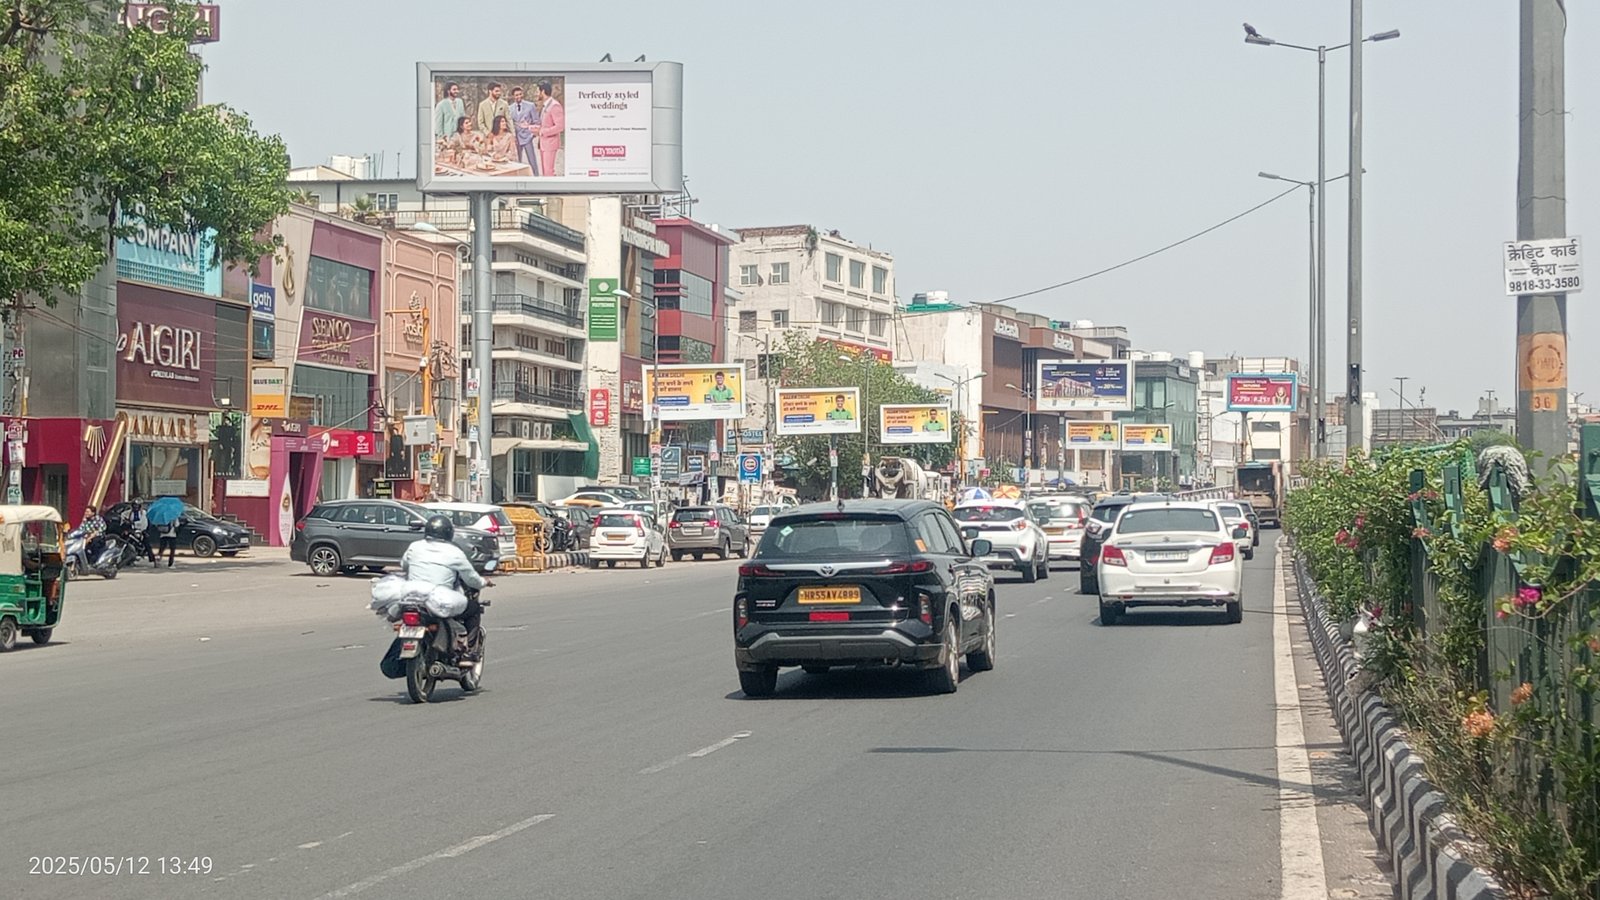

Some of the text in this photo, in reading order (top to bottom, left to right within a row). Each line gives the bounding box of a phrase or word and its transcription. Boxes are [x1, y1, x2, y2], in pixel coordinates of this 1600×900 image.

[579, 91, 639, 100] Perfectly styled
[591, 102, 628, 110] weddings
[127, 222, 200, 261] COMPANY
[1507, 239, 1578, 262] क्रेडिट कार्ड
[1509, 276, 1580, 292] 9818-33-3580
[312, 317, 352, 341] SENCO
[124, 321, 201, 371] AIGIRI
[1534, 396, 1551, 409] 36
